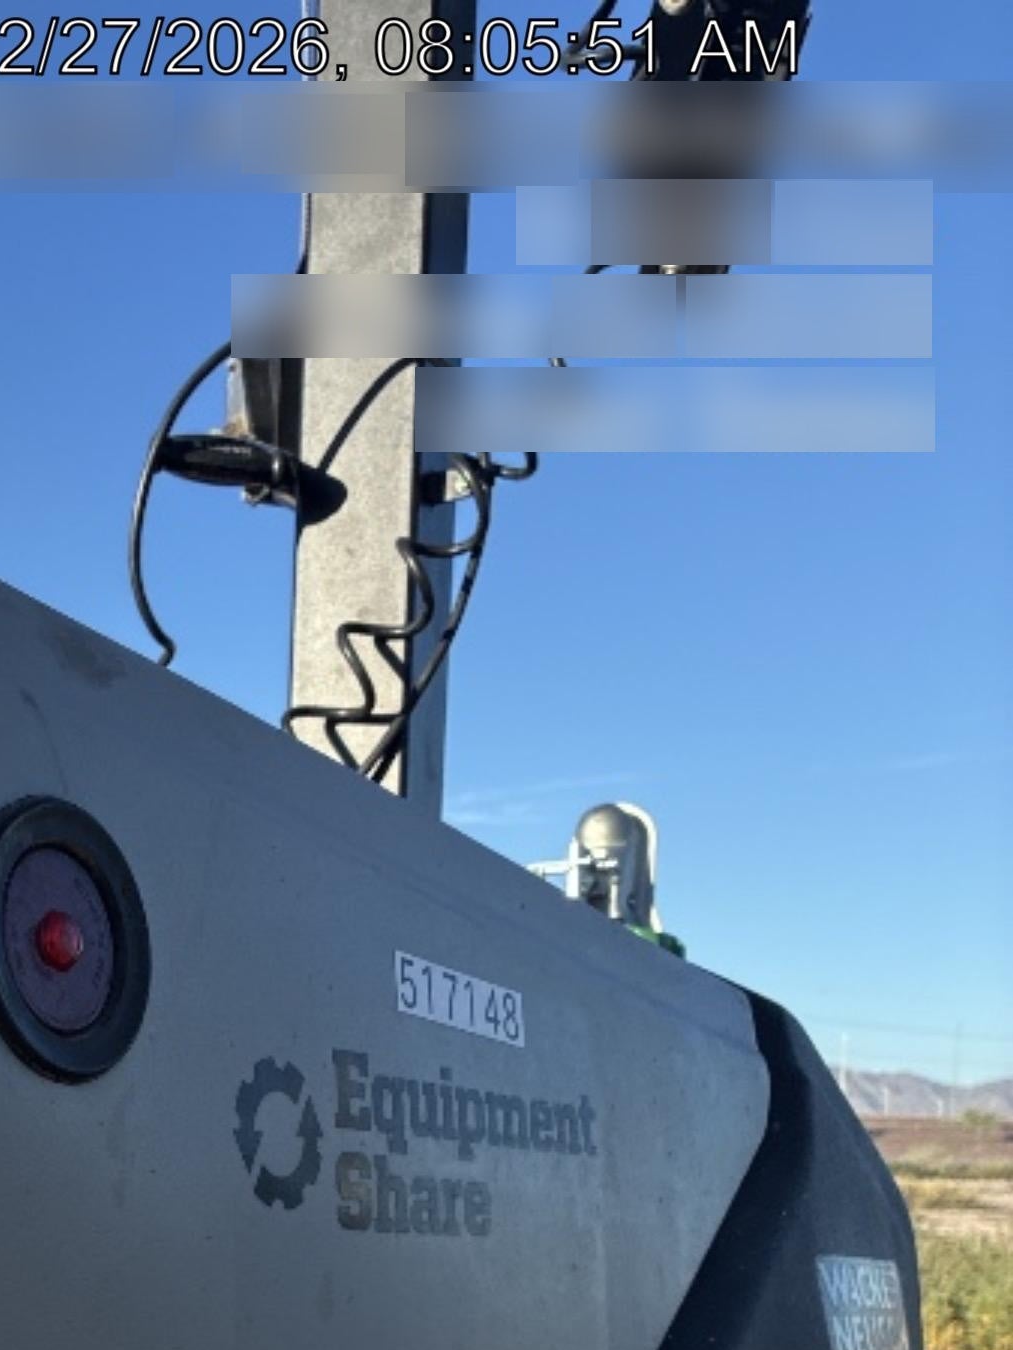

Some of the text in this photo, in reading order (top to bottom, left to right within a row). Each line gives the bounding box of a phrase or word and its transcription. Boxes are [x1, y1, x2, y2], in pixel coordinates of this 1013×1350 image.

[400, 956, 519, 1041] 517148
[331, 1048, 597, 1161] Equipment
[334, 1151, 492, 1237] Share
